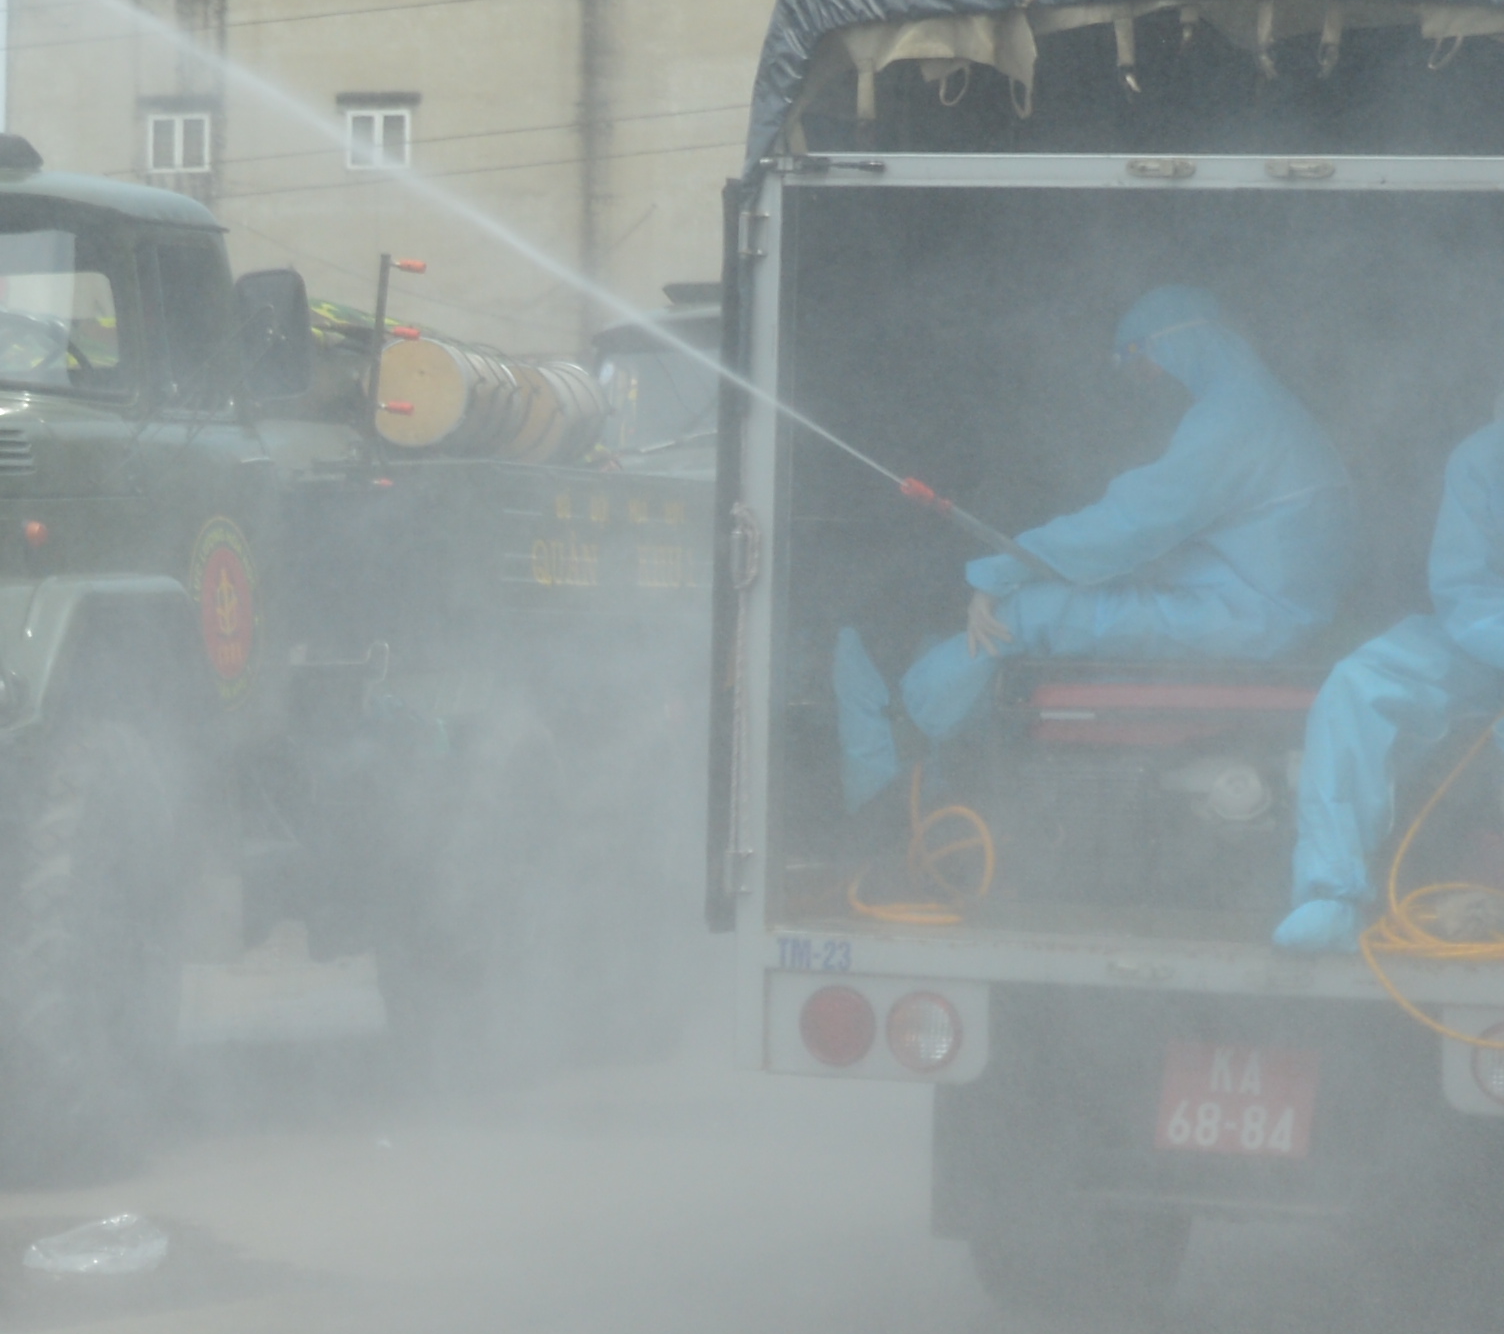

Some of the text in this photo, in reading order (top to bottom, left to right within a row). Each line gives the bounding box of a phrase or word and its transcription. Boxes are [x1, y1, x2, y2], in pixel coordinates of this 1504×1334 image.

[777, 937, 853, 972] TM-23
[1210, 1046, 1263, 1095] KA
[1167, 1099, 1295, 1152] 68-84
